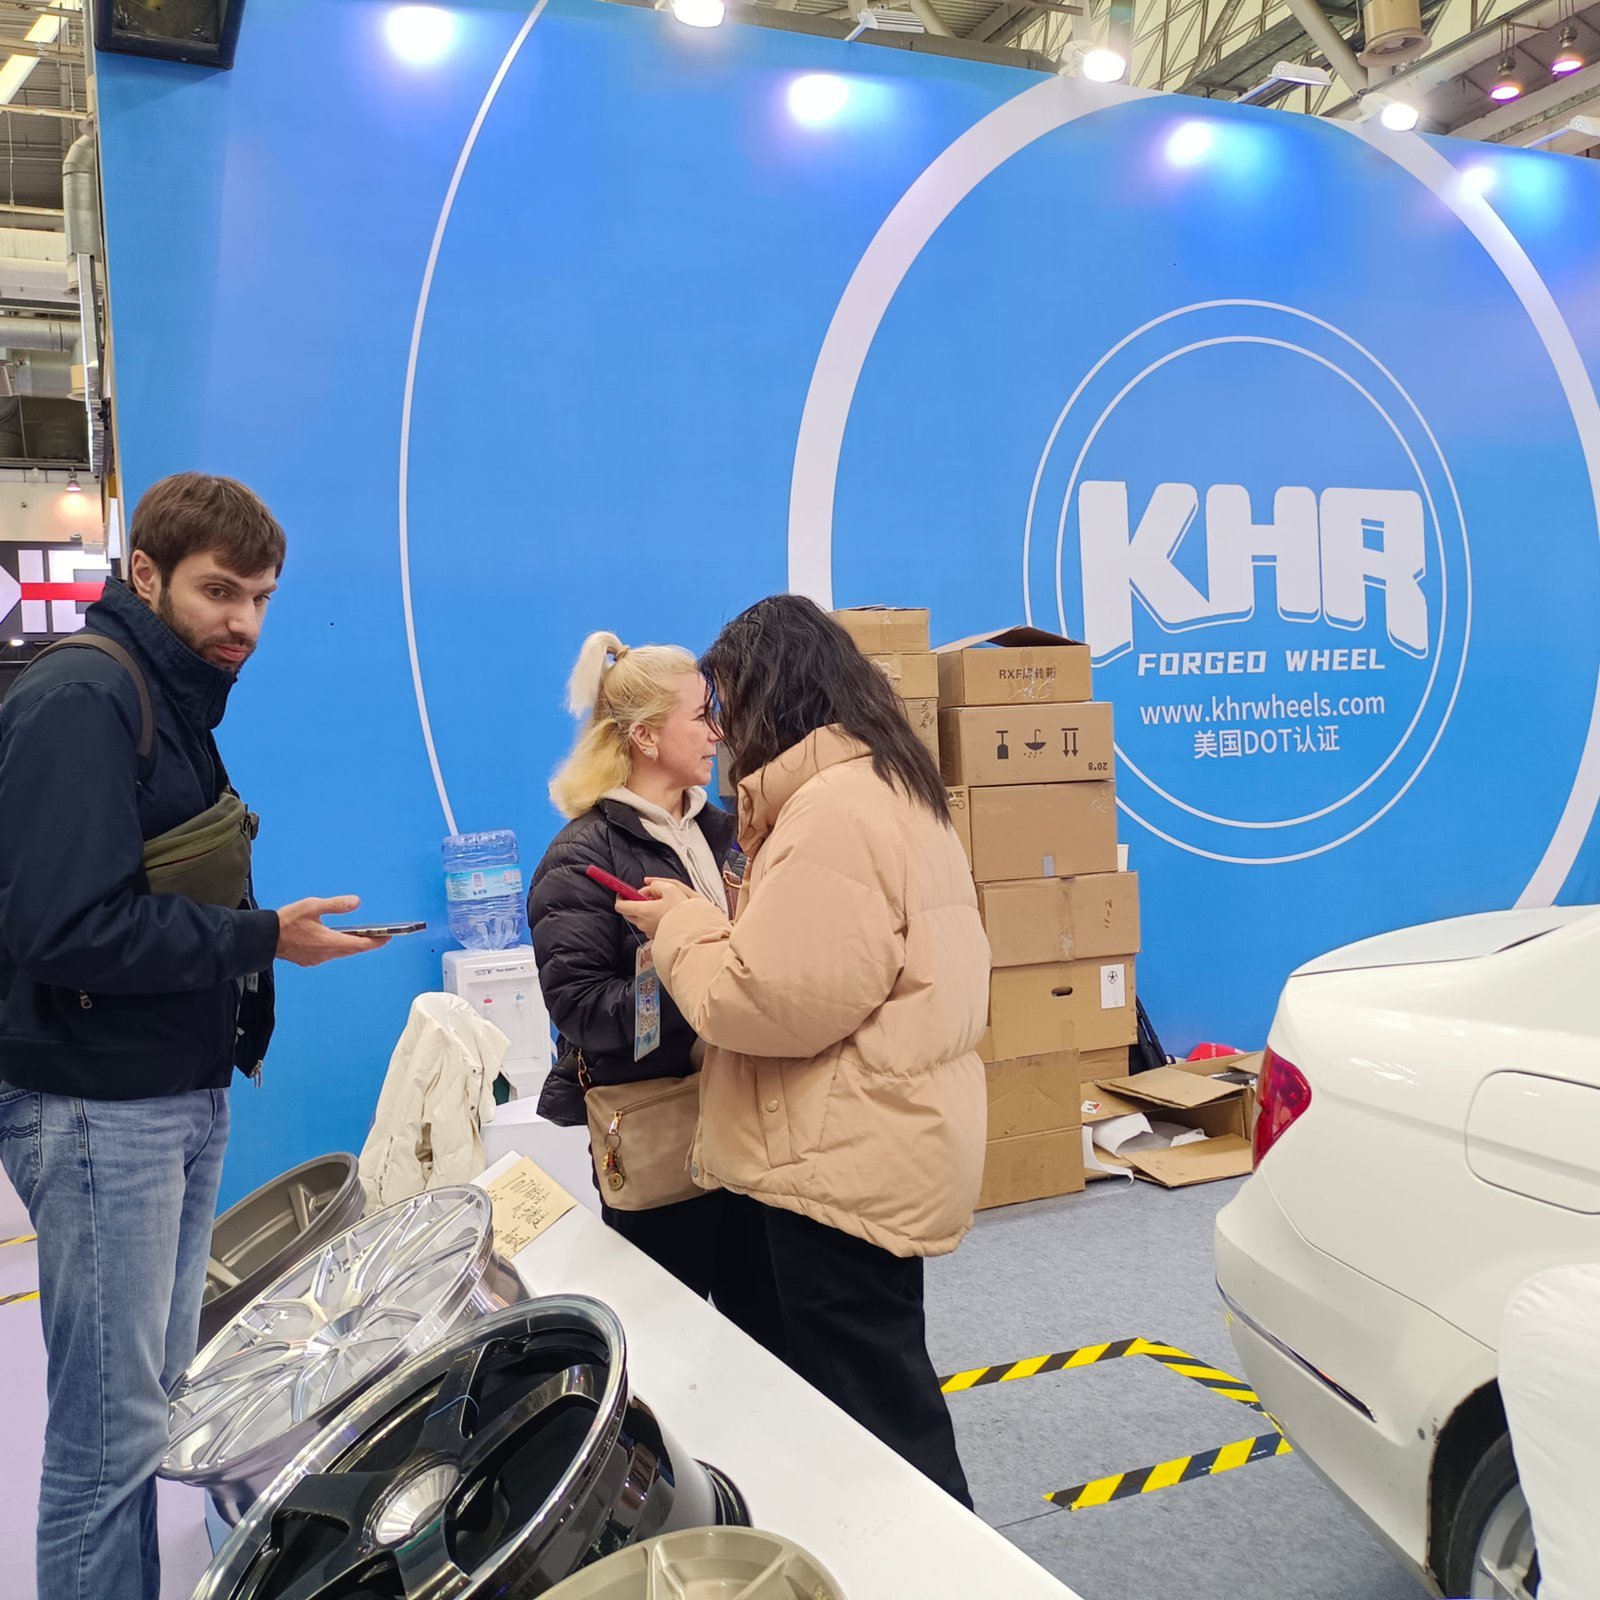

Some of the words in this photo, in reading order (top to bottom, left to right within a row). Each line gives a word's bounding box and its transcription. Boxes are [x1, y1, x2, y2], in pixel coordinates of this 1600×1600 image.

[1078, 480, 1428, 667] KHR
[1137, 651, 1267, 676] FORGED
[1285, 648, 1386, 672] WHEEL
[1140, 692, 1386, 725] www.khrwheels.com
[1193, 725, 1341, 759] 美国DOT认证
